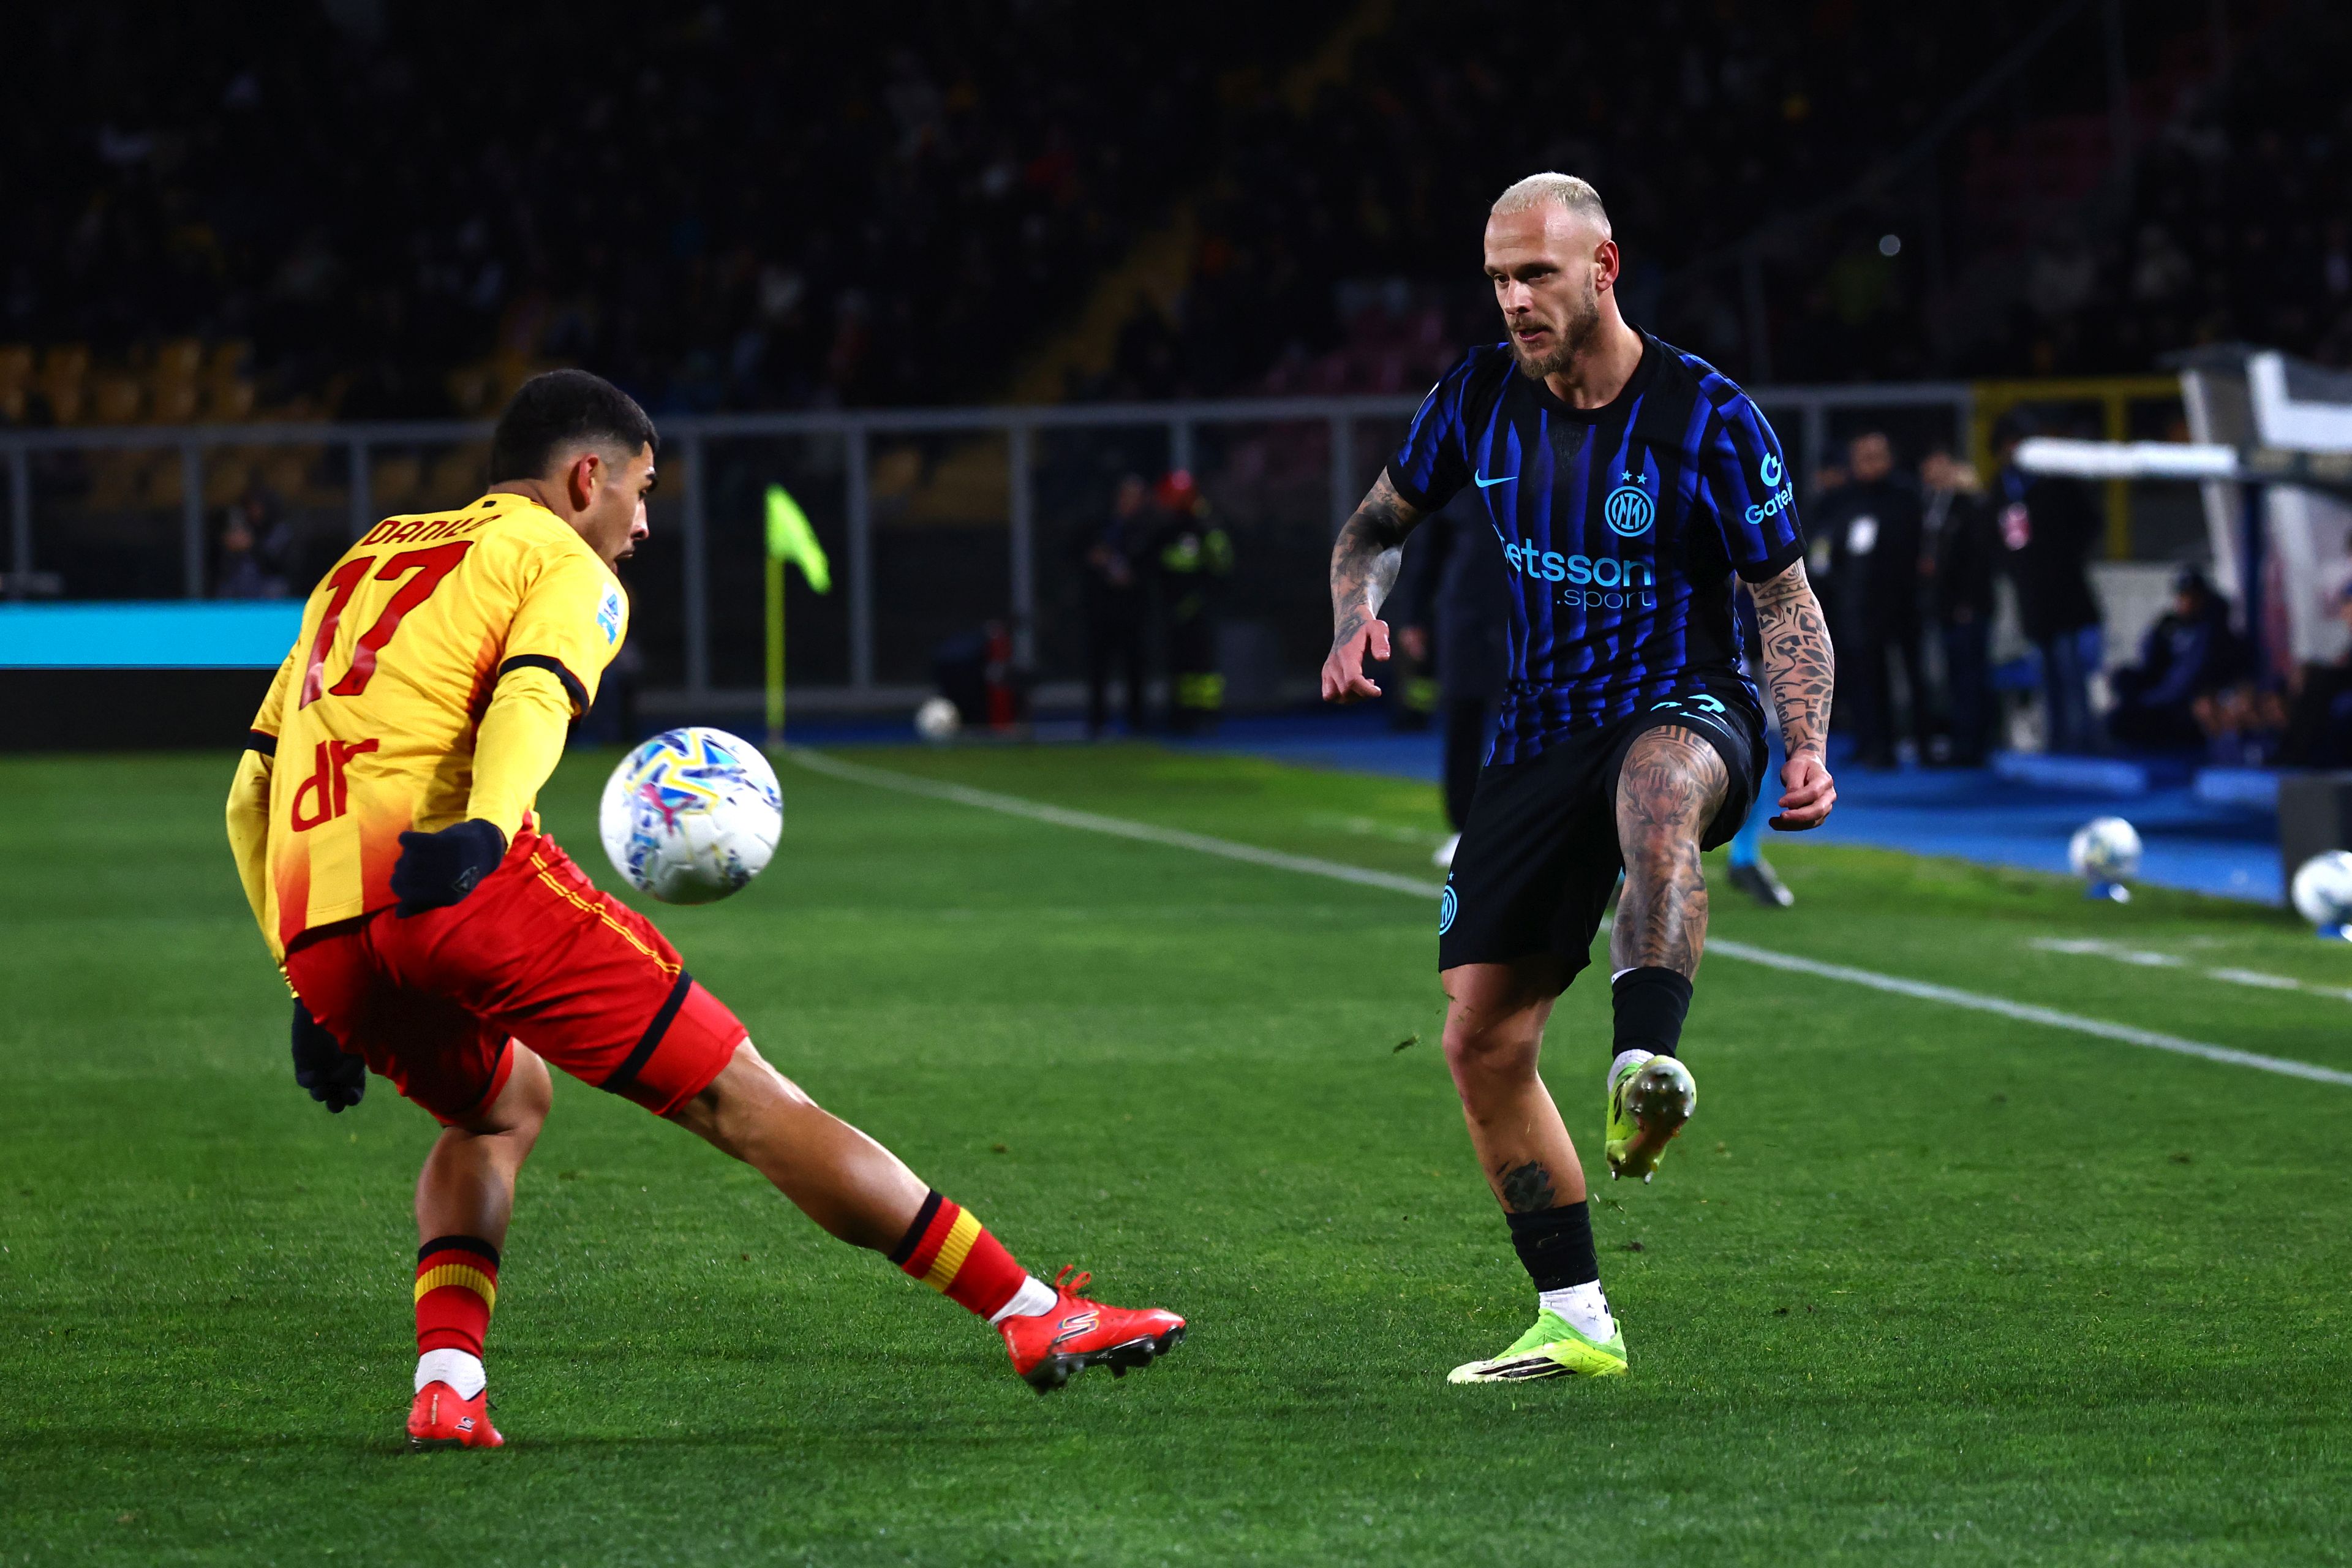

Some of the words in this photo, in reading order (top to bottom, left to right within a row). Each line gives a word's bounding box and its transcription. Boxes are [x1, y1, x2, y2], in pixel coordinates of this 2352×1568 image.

[1492, 524, 1652, 587] etsson
[299, 541, 475, 710] 17
[290, 739, 379, 832] dr
